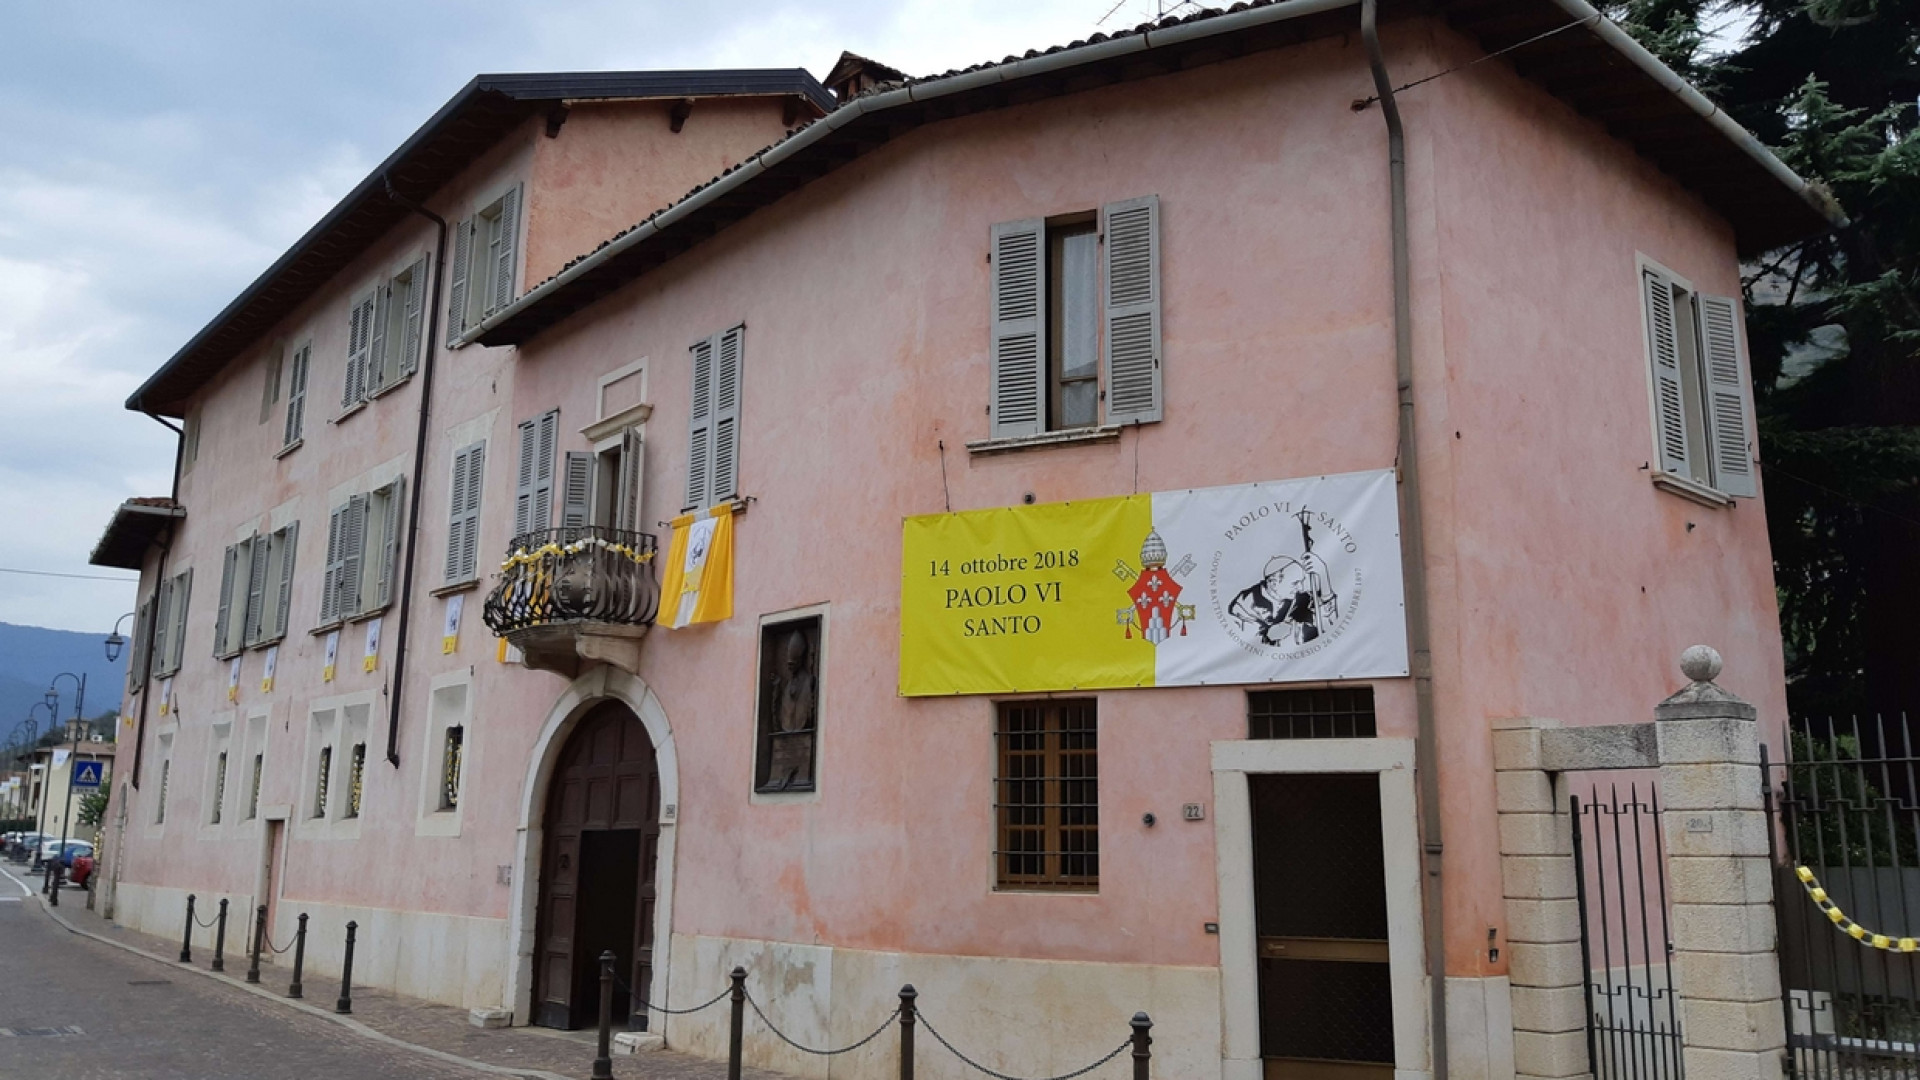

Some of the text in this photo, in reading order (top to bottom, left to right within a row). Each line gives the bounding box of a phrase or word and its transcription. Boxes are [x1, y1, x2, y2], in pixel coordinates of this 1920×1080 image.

[1224, 502, 1357, 553] PAOLO VI SANTO
[930, 549, 1080, 577] 14 ottobre 2018
[945, 581, 1062, 609] PAOLO VI
[1209, 550, 1223, 586] GIOVAN
[1271, 645, 1321, 660] CONCESIO
[963, 615, 1042, 637] SANTO
[1187, 805, 1199, 818] 22
